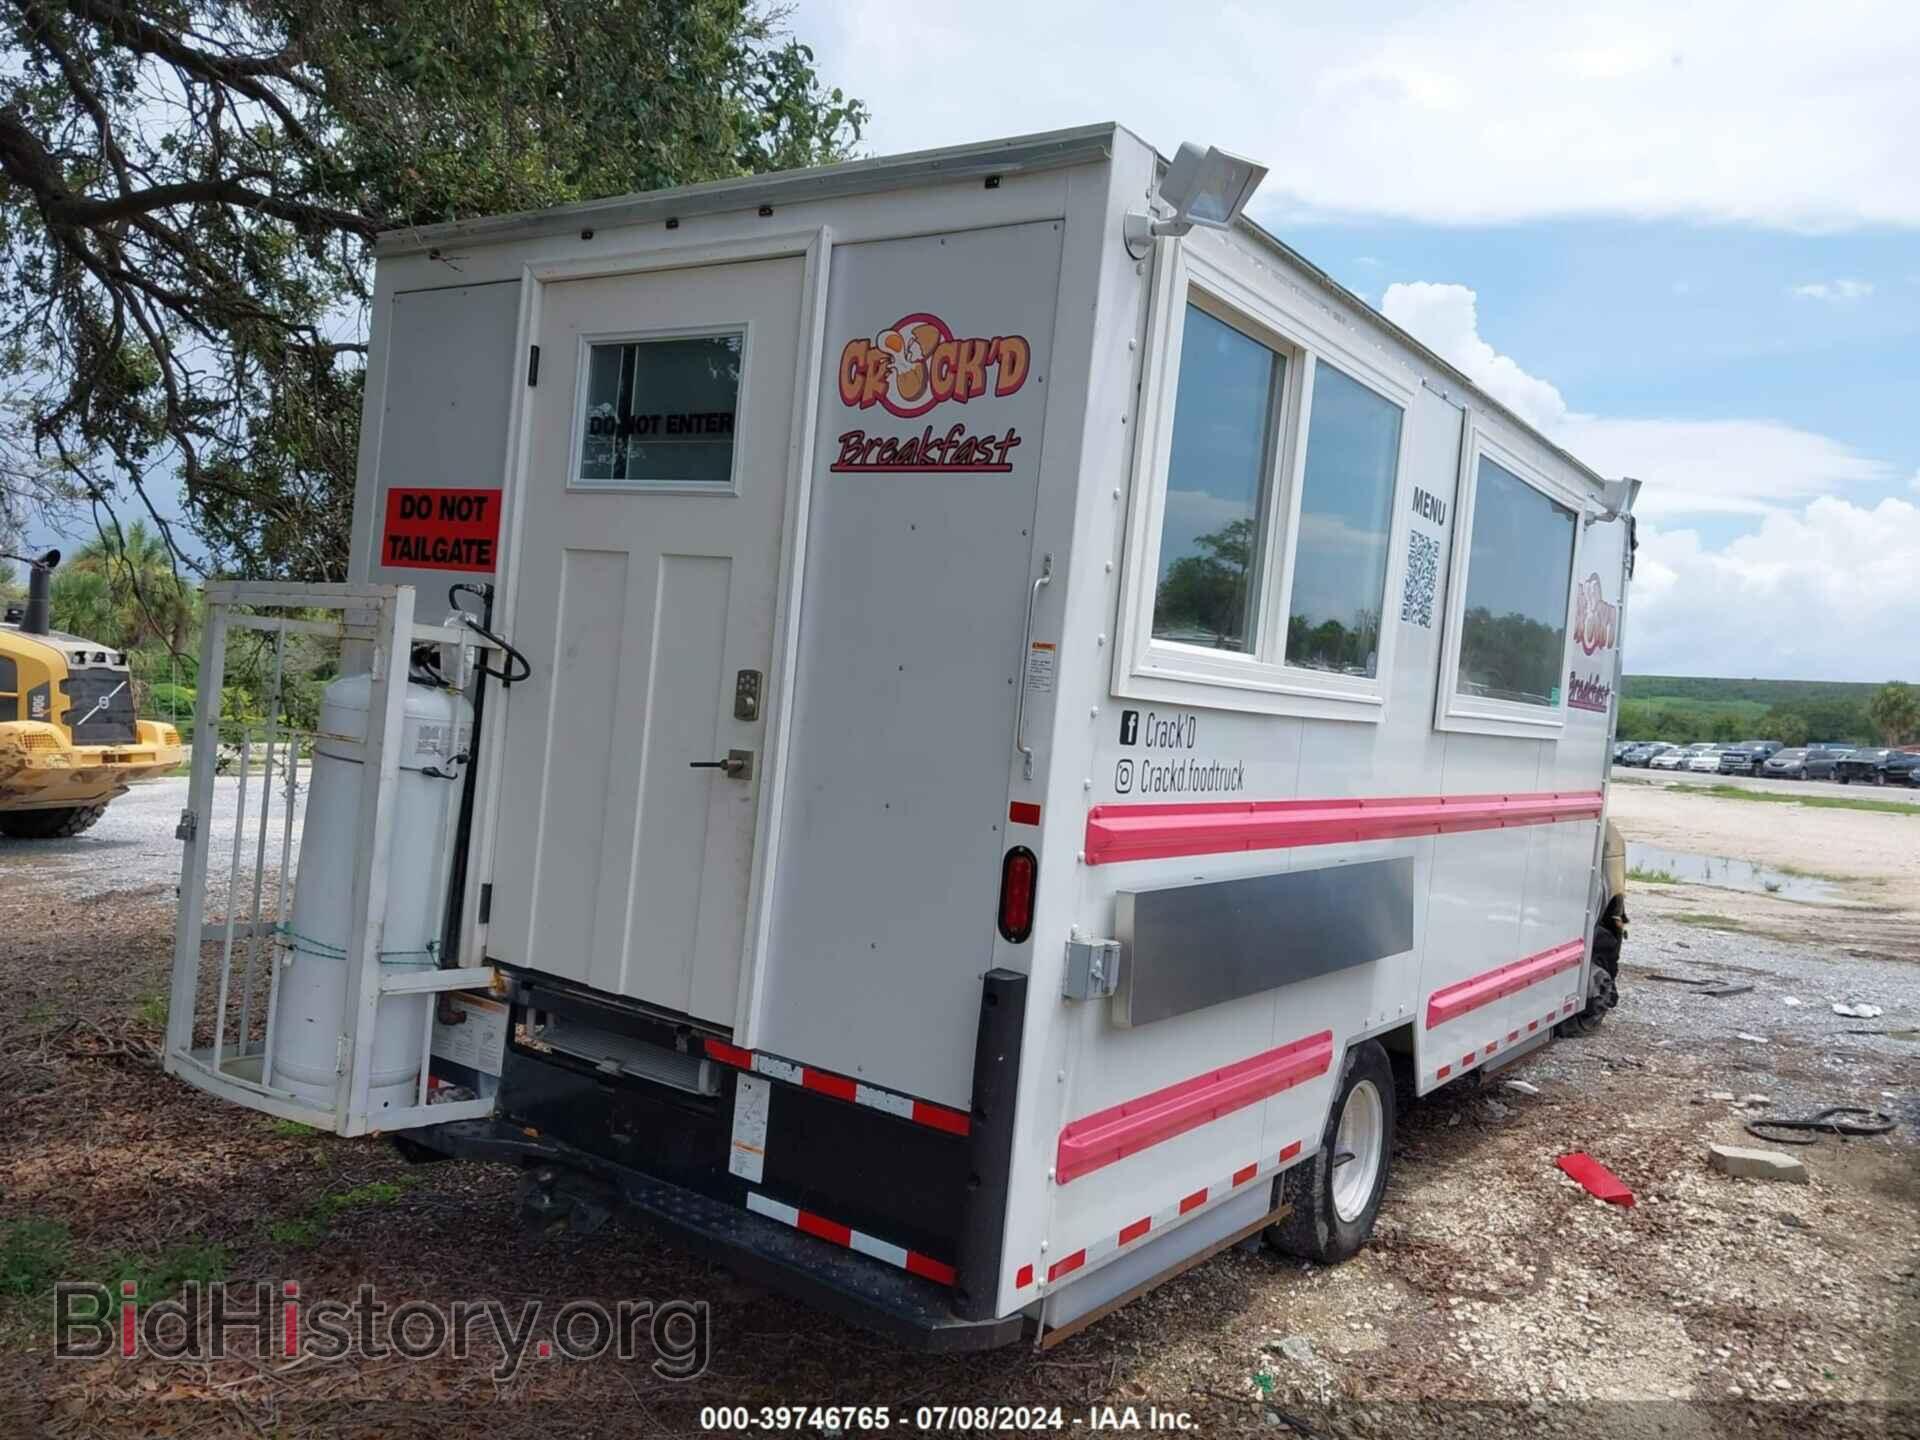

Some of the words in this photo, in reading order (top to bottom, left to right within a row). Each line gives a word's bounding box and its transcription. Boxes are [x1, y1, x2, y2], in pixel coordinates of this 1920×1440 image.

[839, 335, 1031, 410] CRCK'D
[590, 415, 616, 435] DO
[665, 412, 734, 433] ENTER
[838, 423, 1022, 466] Breakfast
[400, 494, 433, 520] DO
[439, 495, 489, 522] NOT
[1411, 486, 1446, 526] MENU
[388, 534, 493, 565] TAILGATE
[1145, 711, 1197, 749] Crack'D
[1141, 758, 1245, 793] Crackd.foodtruck
